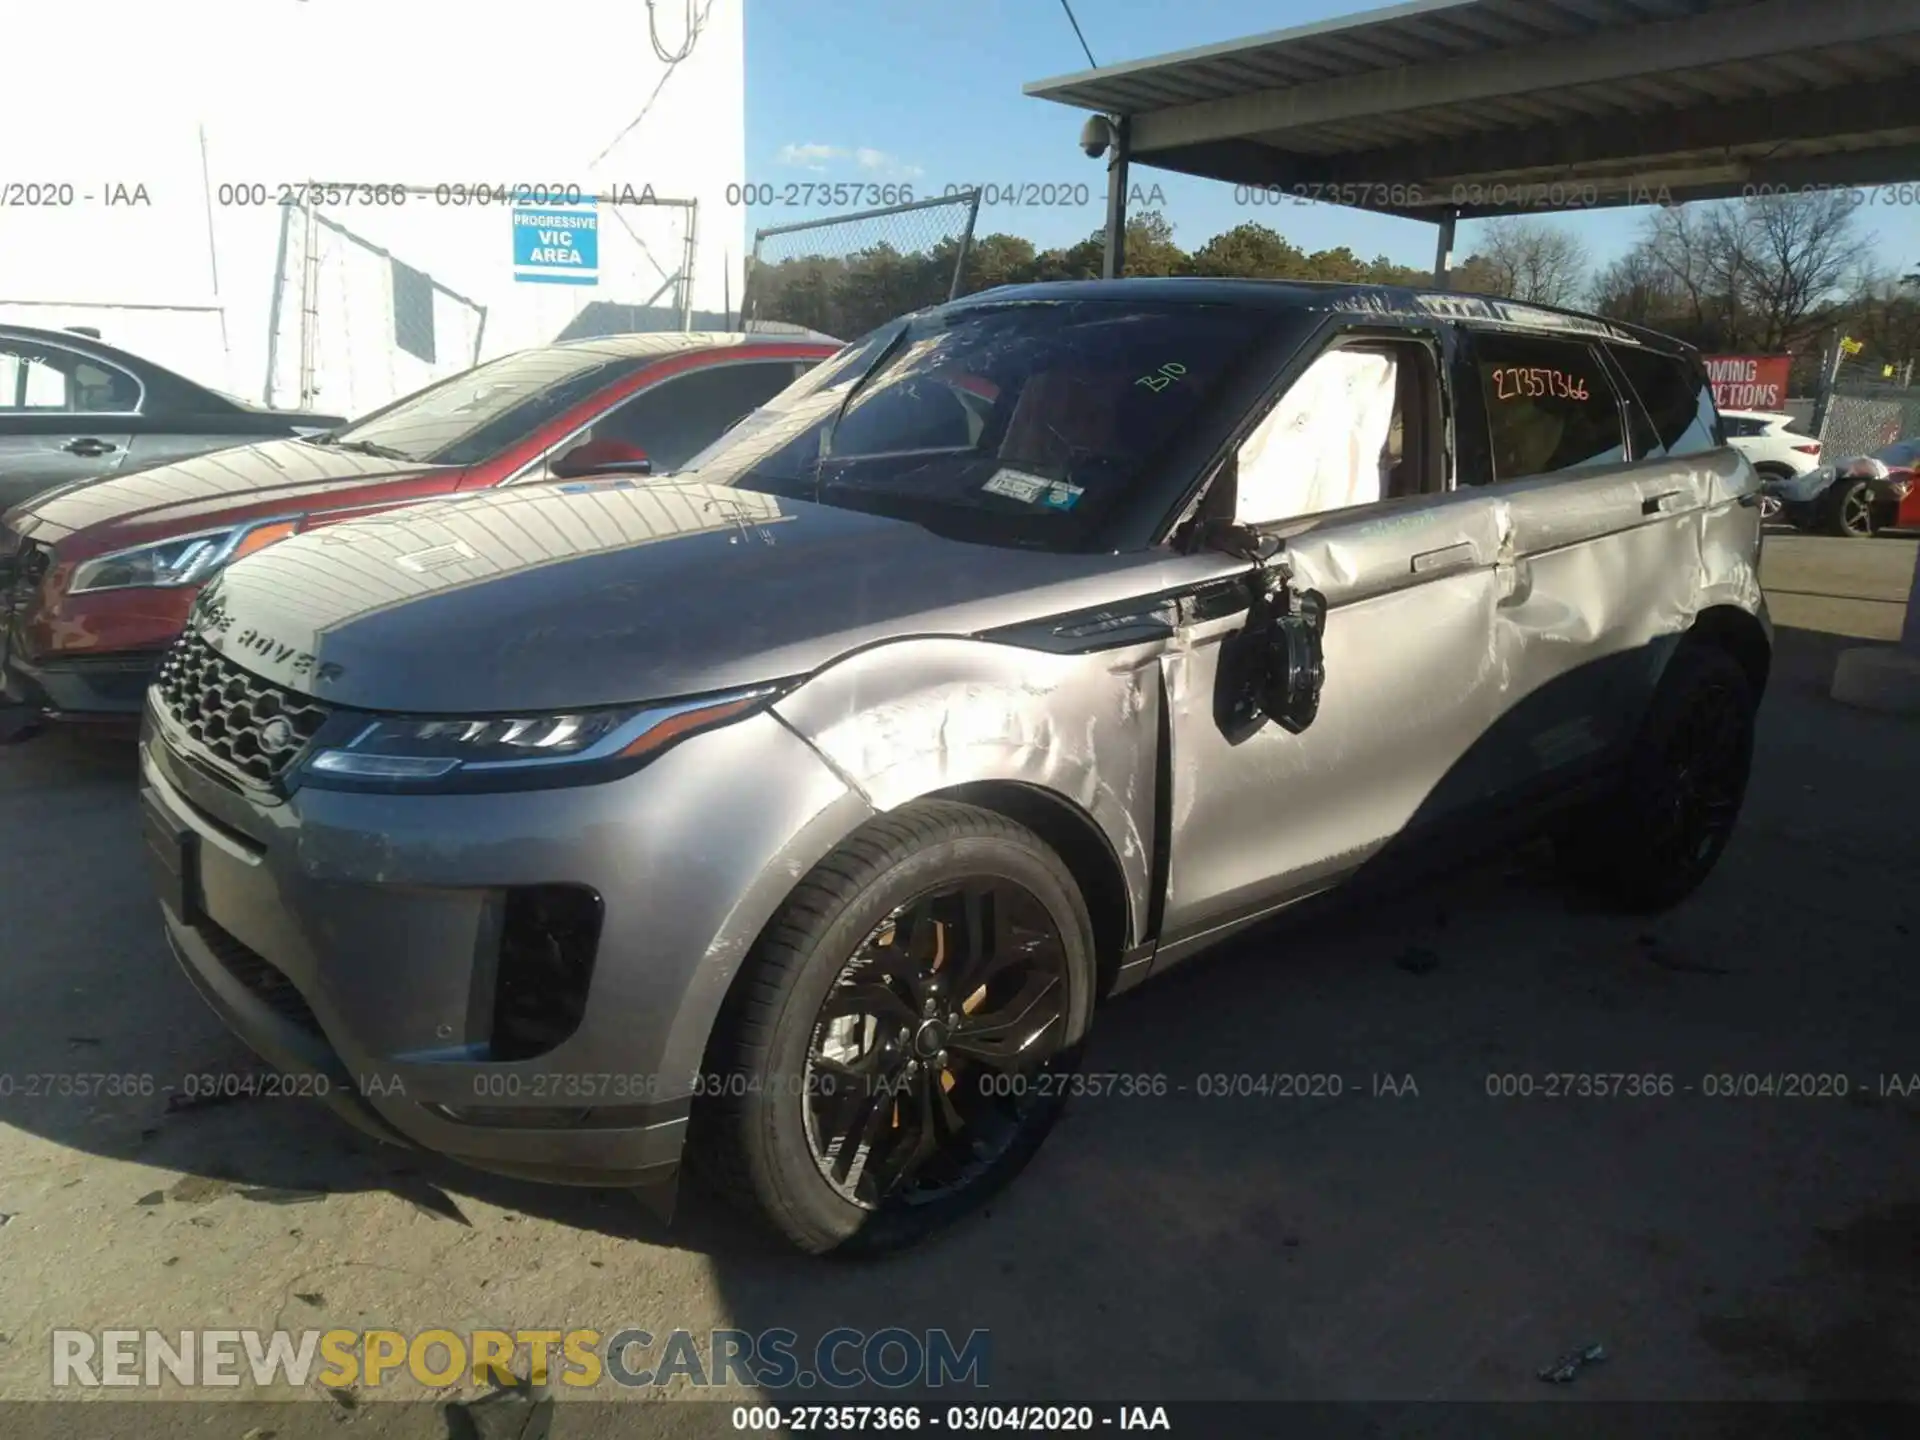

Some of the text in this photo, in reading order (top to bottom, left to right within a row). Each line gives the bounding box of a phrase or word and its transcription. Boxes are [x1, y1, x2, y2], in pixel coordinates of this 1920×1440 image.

[514, 213, 596, 230] PROGRESSIVE
[538, 229, 573, 247] VIC
[530, 247, 583, 265] AREA
[1492, 367, 1590, 401] 27357366
